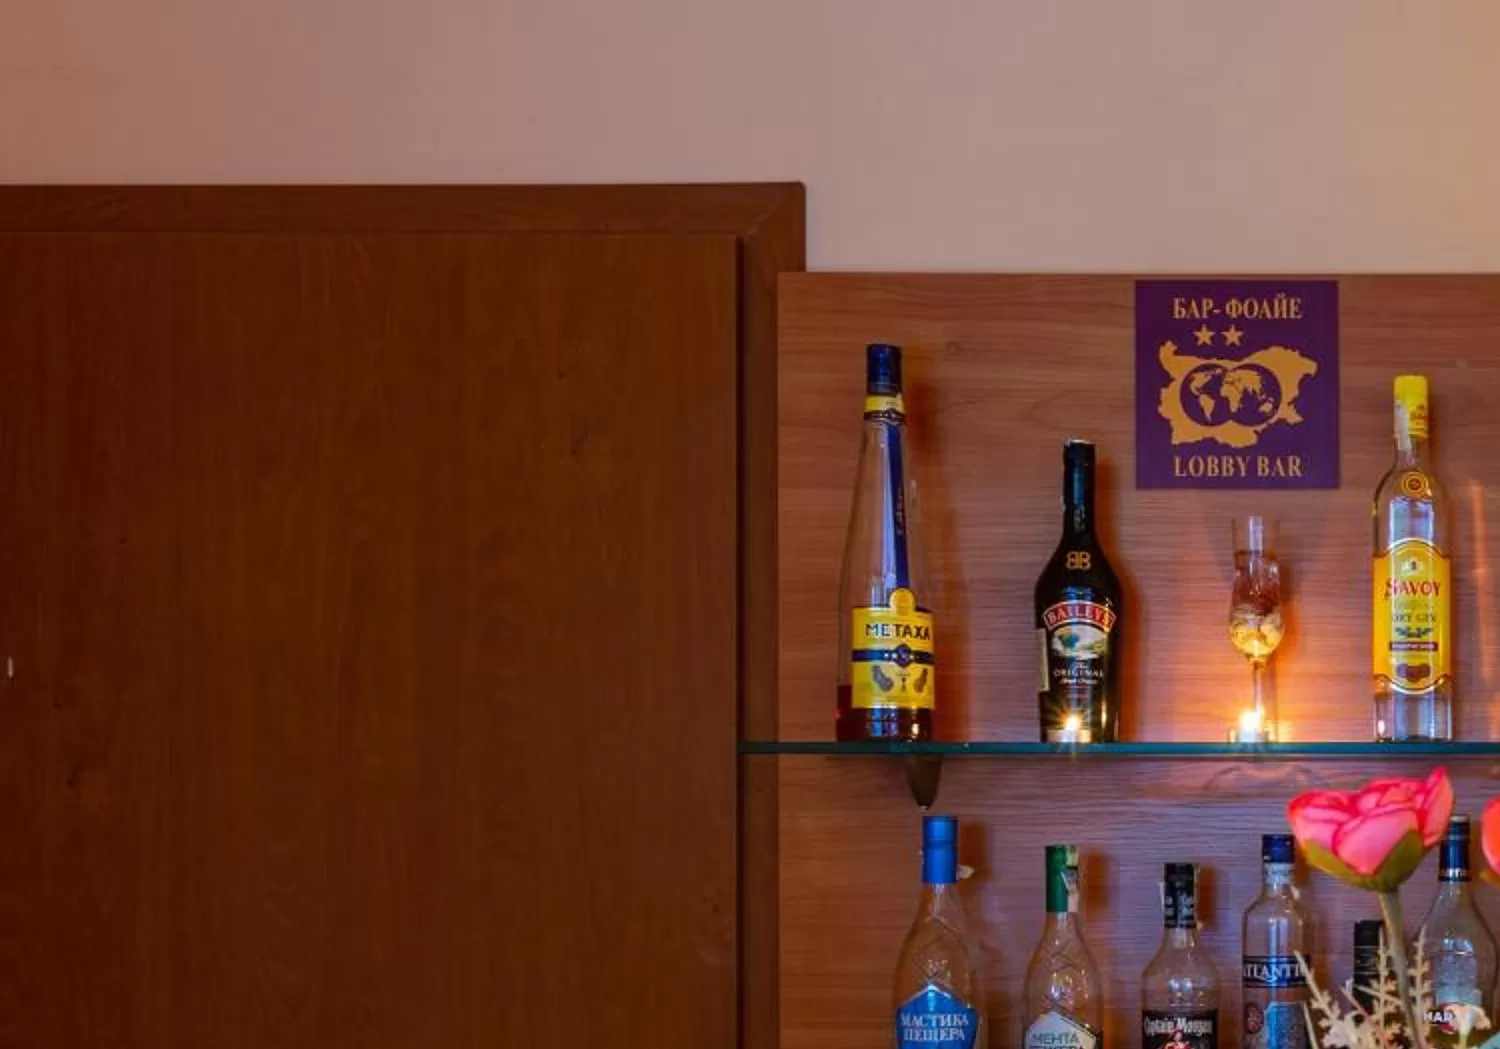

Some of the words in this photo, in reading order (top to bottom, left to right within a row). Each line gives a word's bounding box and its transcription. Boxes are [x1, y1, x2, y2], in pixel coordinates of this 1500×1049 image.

[1173, 455, 1250, 478] LOBBY
[1256, 455, 1303, 478] BAR
[1384, 578, 1441, 597] SAVOY
[1047, 605, 1113, 628] BAILEYS
[864, 622, 931, 641] METAXA
[900, 1012, 969, 1028] МАСТИКА
[903, 1027, 965, 1043] ПЕЩЕРА
[1032, 1031, 1080, 1044] МЕНТА
